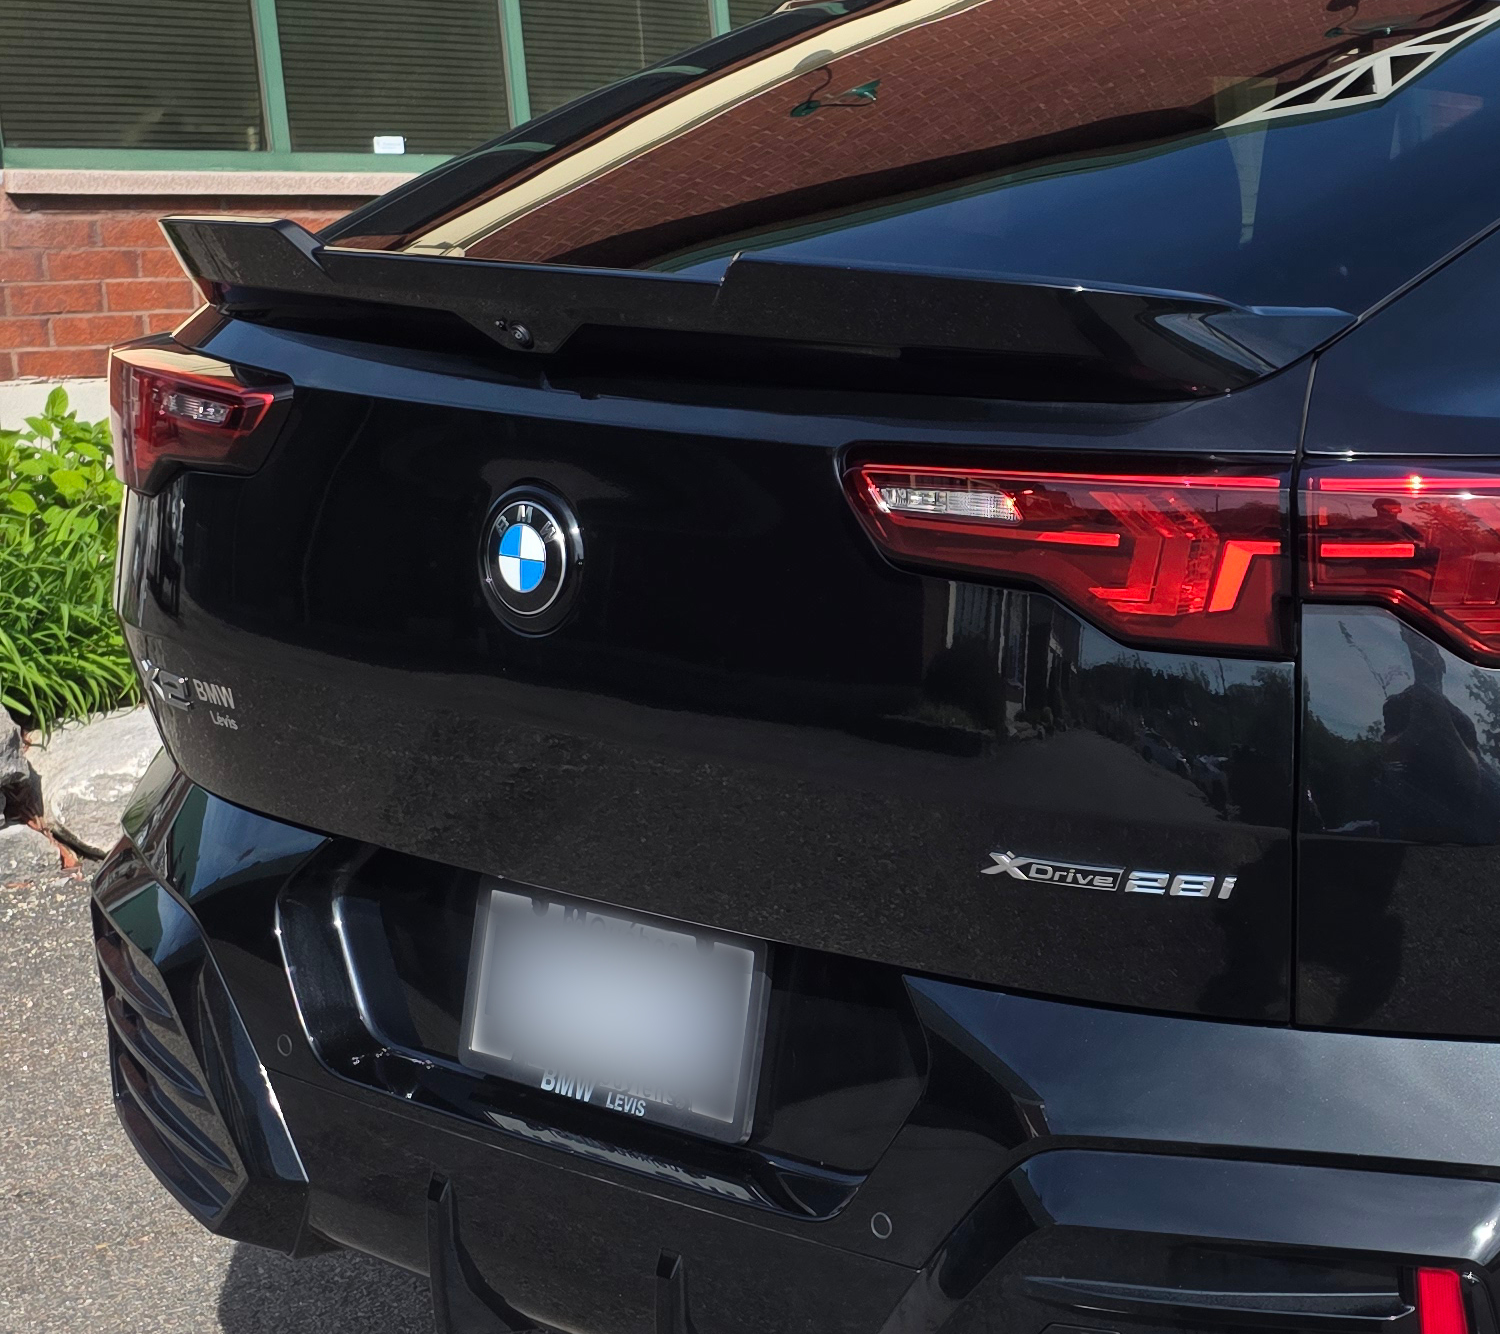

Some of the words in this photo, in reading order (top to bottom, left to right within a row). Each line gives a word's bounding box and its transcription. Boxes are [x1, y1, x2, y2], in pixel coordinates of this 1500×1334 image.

[495, 504, 558, 544] BMW
[192, 678, 236, 710] BMW
[540, 1067, 596, 1103] BMW
[605, 1091, 647, 1117] LEVIS
